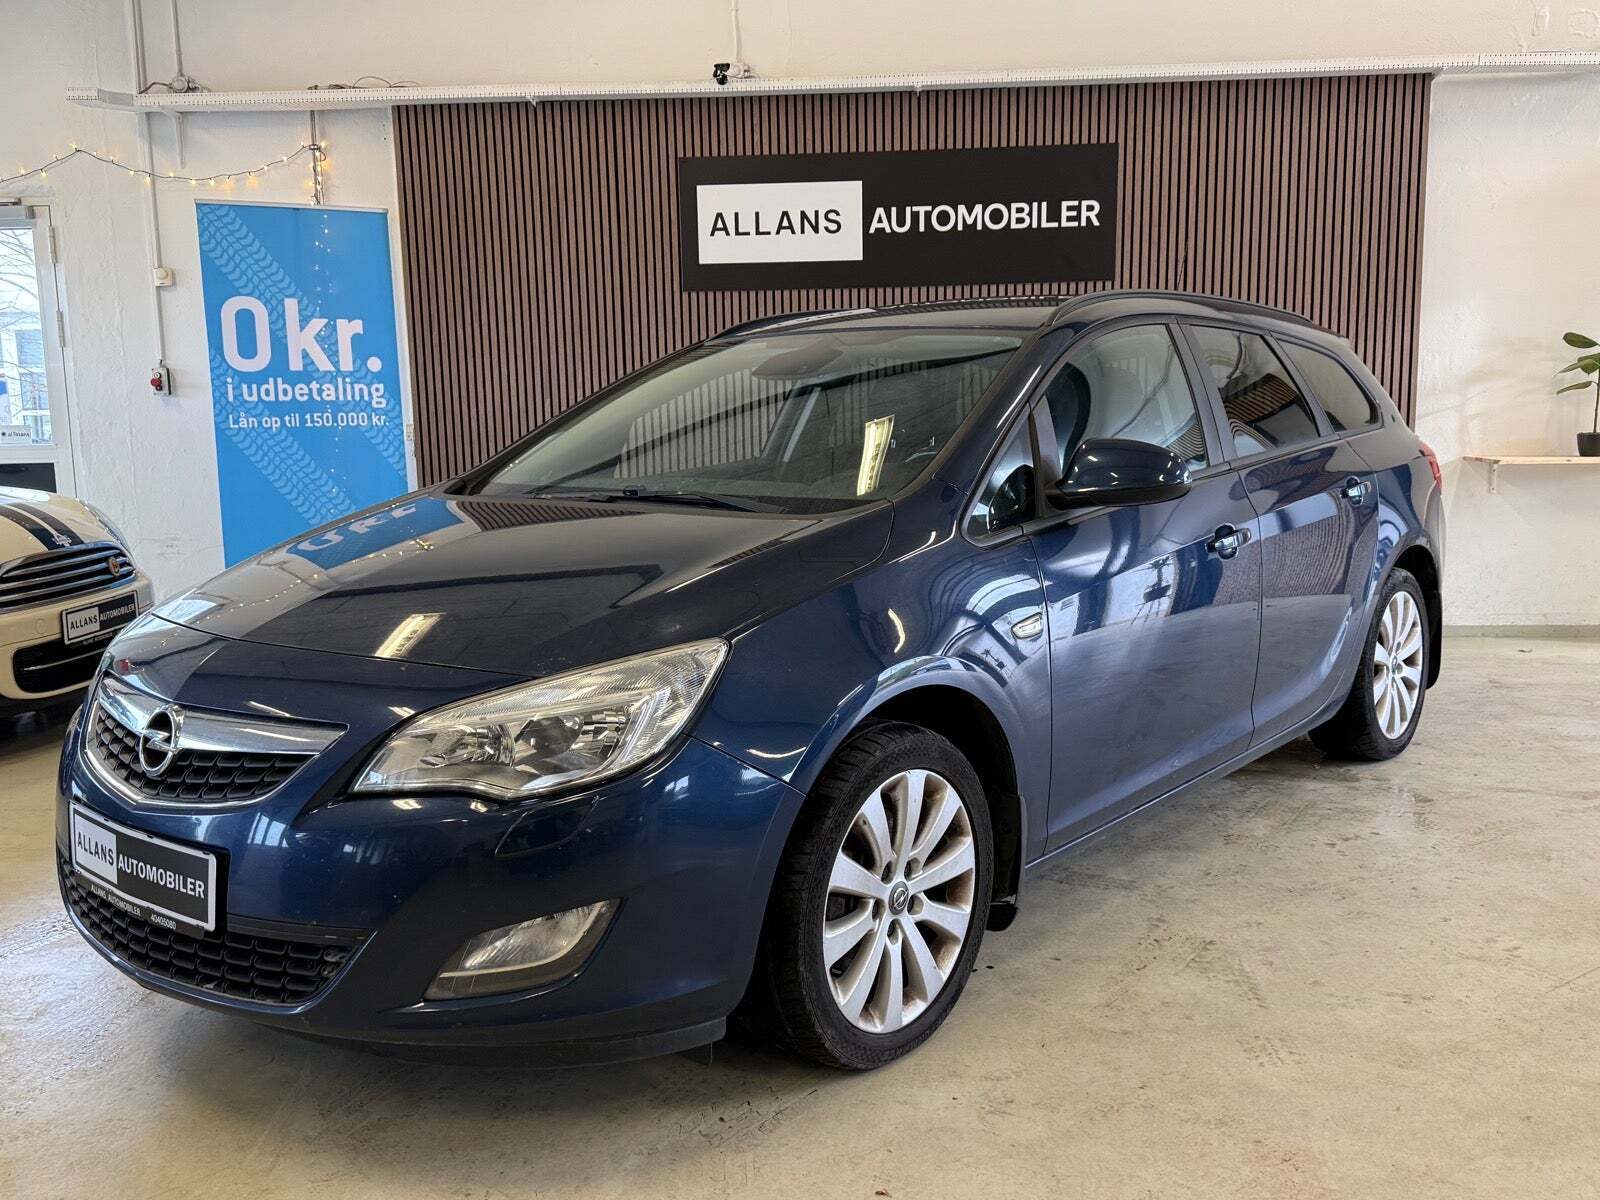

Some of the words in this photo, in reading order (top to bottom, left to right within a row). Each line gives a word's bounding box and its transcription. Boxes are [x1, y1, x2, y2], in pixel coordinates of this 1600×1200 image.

[709, 208, 842, 237] ALLANS
[868, 199, 1101, 235] AUTOMOBILER
[220, 295, 272, 373] 0
[284, 297, 383, 373] kr.
[226, 377, 234, 402] i
[242, 377, 387, 408] udbetaling
[229, 412, 258, 429] Lån
[262, 418, 281, 432] op
[284, 413, 300, 428] til
[304, 412, 368, 428] 150.000
[371, 412, 390, 427] kr.
[70, 614, 98, 631] ALLANS
[99, 603, 136, 621] AUTOMOBILER
[77, 831, 115, 867] ALLANS
[118, 853, 205, 899] AUTOMOBILER
[90, 884, 107, 899] ALLANS
[107, 893, 142, 917] AUTOMOBILER
